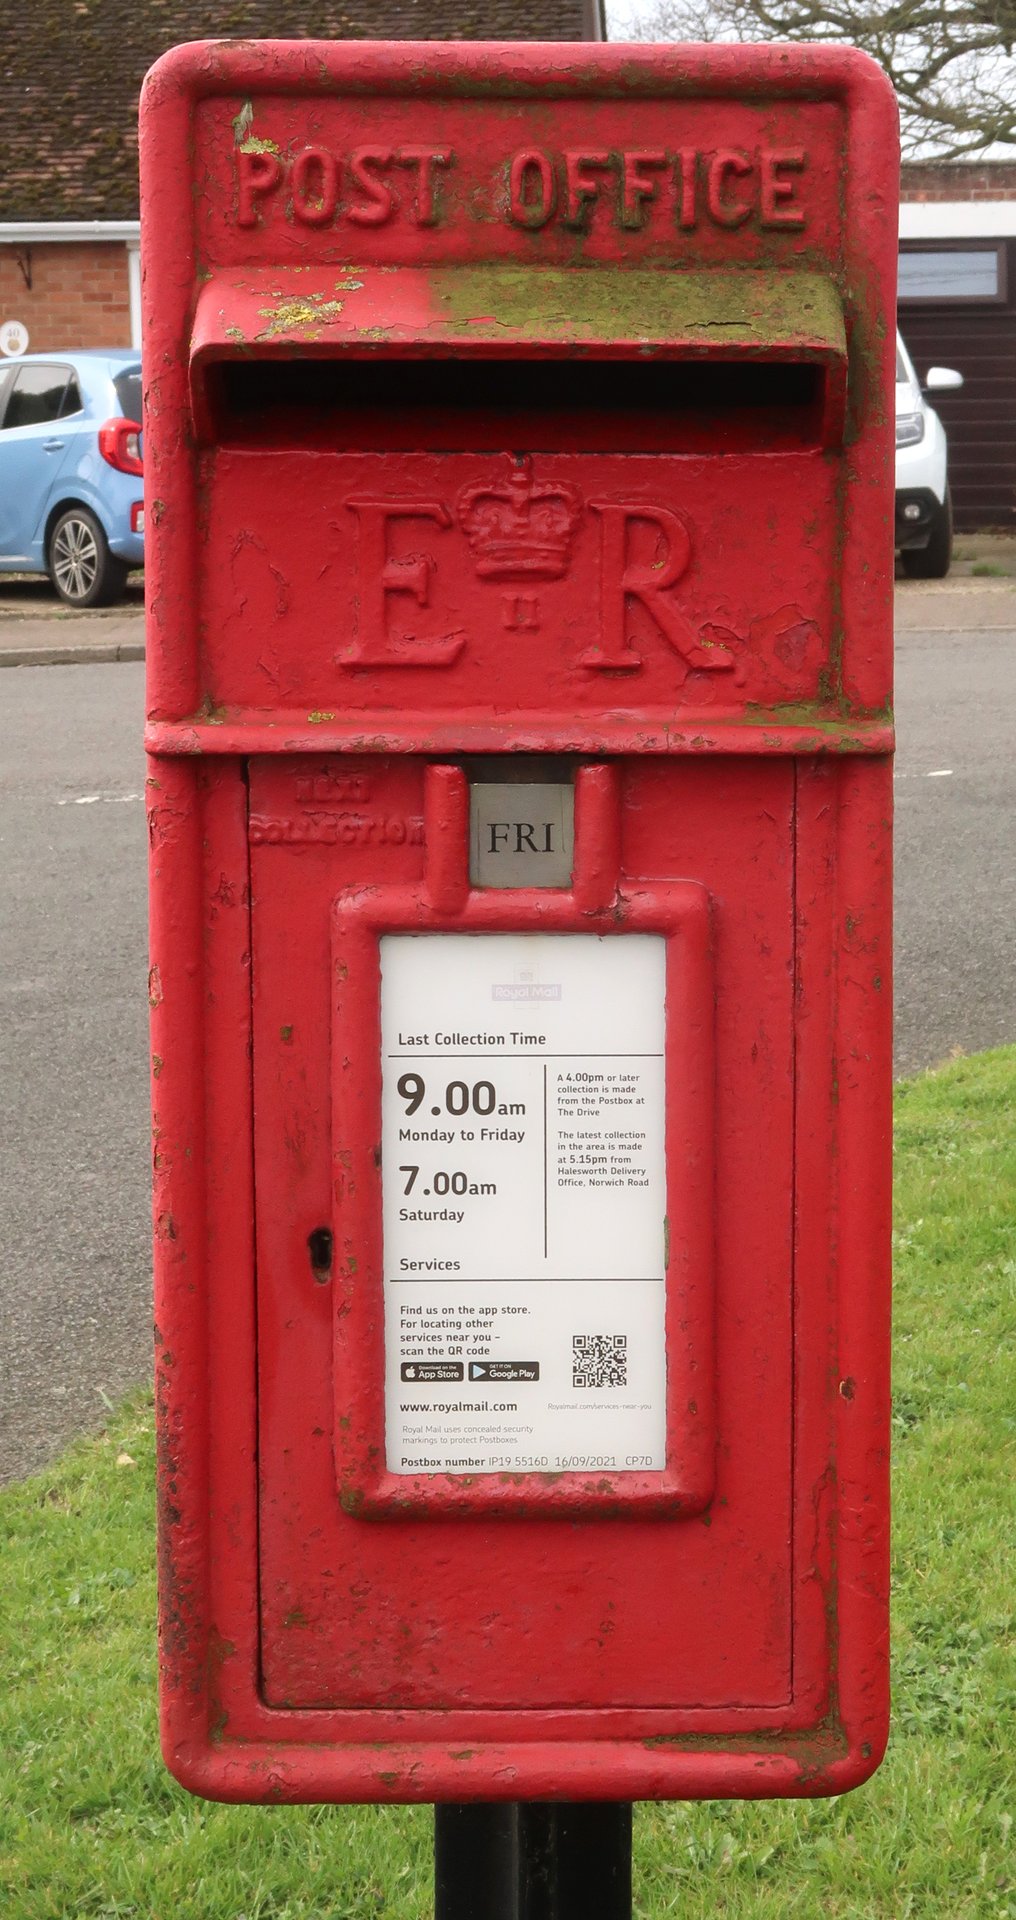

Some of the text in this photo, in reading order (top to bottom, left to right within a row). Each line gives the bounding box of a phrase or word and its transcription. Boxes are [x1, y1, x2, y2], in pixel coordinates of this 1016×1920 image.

[235, 143, 806, 231] POST OFFICE
[339, 499, 736, 671] E R
[486, 822, 556, 854] FRI
[495, 985, 559, 1001] Royal Mail
[398, 1031, 547, 1046] Last Collection Time
[556, 1073, 564, 1082] A
[565, 1072, 604, 1084] 4.00pm
[619, 1073, 641, 1082] later
[396, 1072, 526, 1117] 9.00am
[557, 1085, 637, 1094] collection is made
[557, 1096, 646, 1105] from the Postbox at
[557, 1107, 601, 1117] The Drive
[398, 1127, 526, 1144] Monday to Friday
[557, 1130, 646, 1140] The latest collection
[557, 1142, 566, 1151] in
[568, 1142, 584, 1151] the
[607, 1142, 616, 1151] is
[617, 1142, 643, 1151] made
[557, 1154, 632, 1166] at 5.15pm from
[557, 1166, 647, 1177] Halesworth Delivery
[398, 1165, 497, 1197] 7.00am
[557, 1177, 650, 1188] Office, Norwich Road
[398, 1207, 465, 1224] Saturday
[399, 1257, 461, 1272] Services
[399, 1305, 531, 1317] Find us on the app store.
[400, 1318, 495, 1331] For locating other
[399, 1332, 443, 1343] services
[445, 1334, 471, 1342] near
[472, 1334, 492, 1344] you
[399, 1345, 491, 1356] scan the QR code
[418, 1370, 460, 1379] App Store
[489, 1369, 536, 1379] Google Play
[399, 1400, 518, 1415] www.royalmail.com
[402, 1425, 534, 1436] Royal Mail uses concealed security
[402, 1435, 438, 1446] markings
[450, 1436, 477, 1445] protect
[479, 1435, 518, 1444] Postboxes
[400, 1455, 653, 1468] Postbox number IP19 5516D 16/09/2021 CP7D
